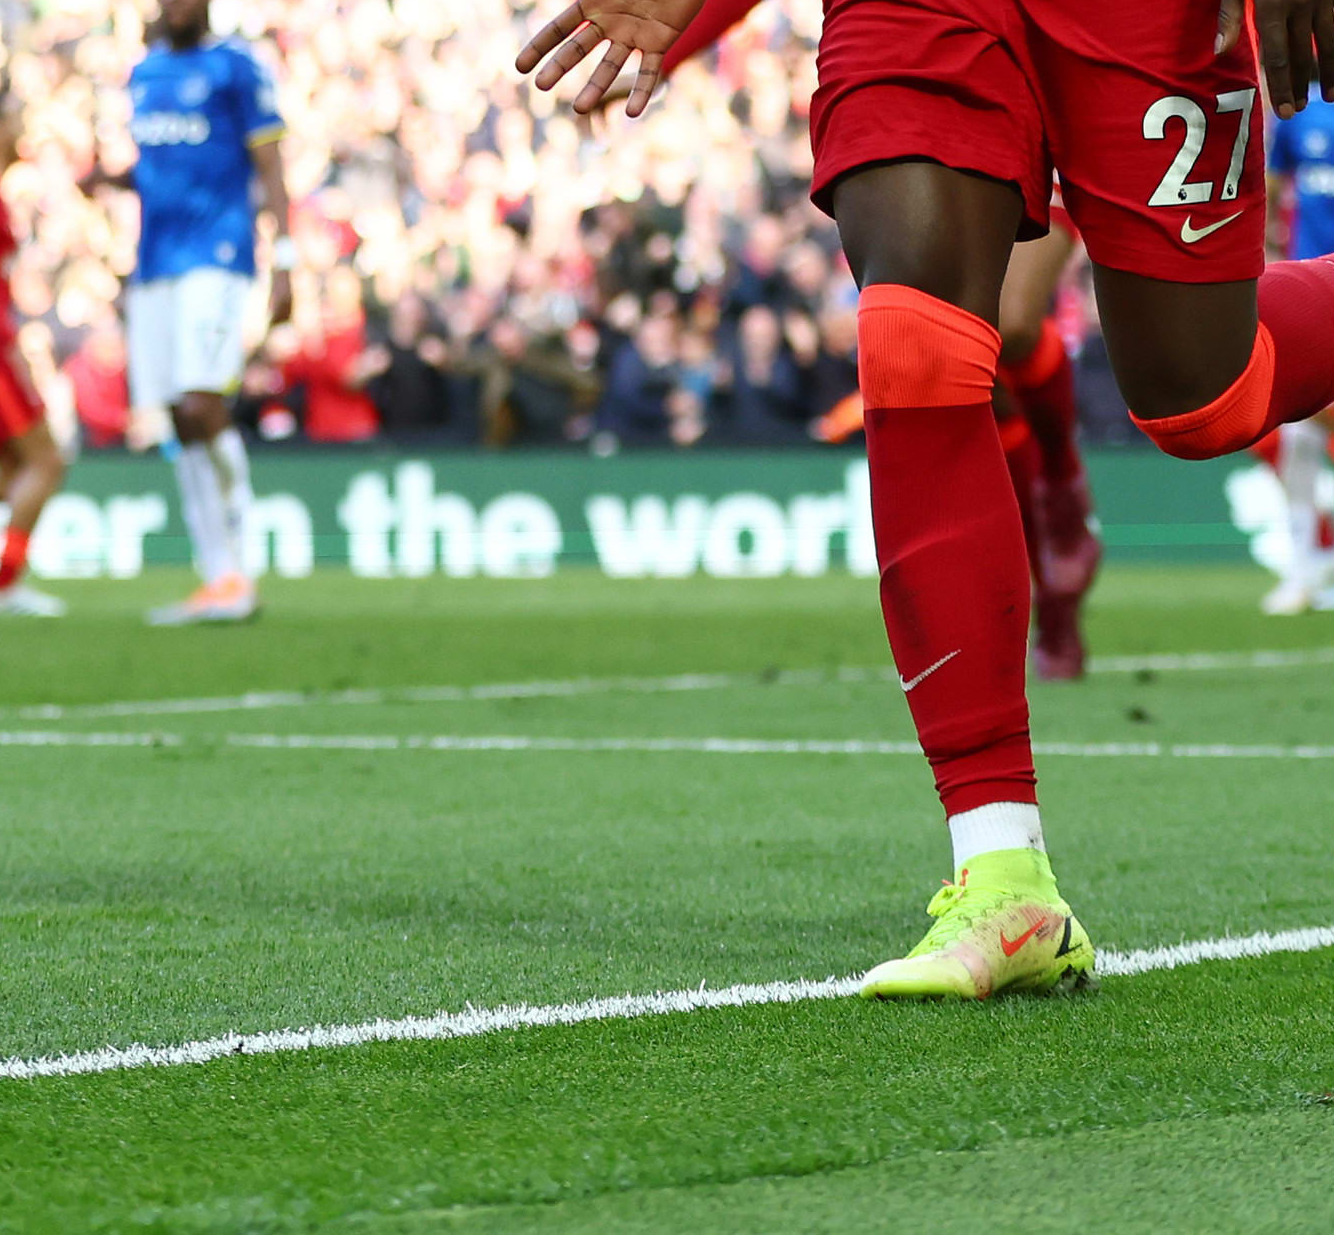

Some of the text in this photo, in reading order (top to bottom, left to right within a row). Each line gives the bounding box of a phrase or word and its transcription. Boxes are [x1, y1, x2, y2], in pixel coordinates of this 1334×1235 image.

[1142, 88, 1256, 206] 27
[336, 460, 563, 578] the
[585, 458, 880, 579] worl
